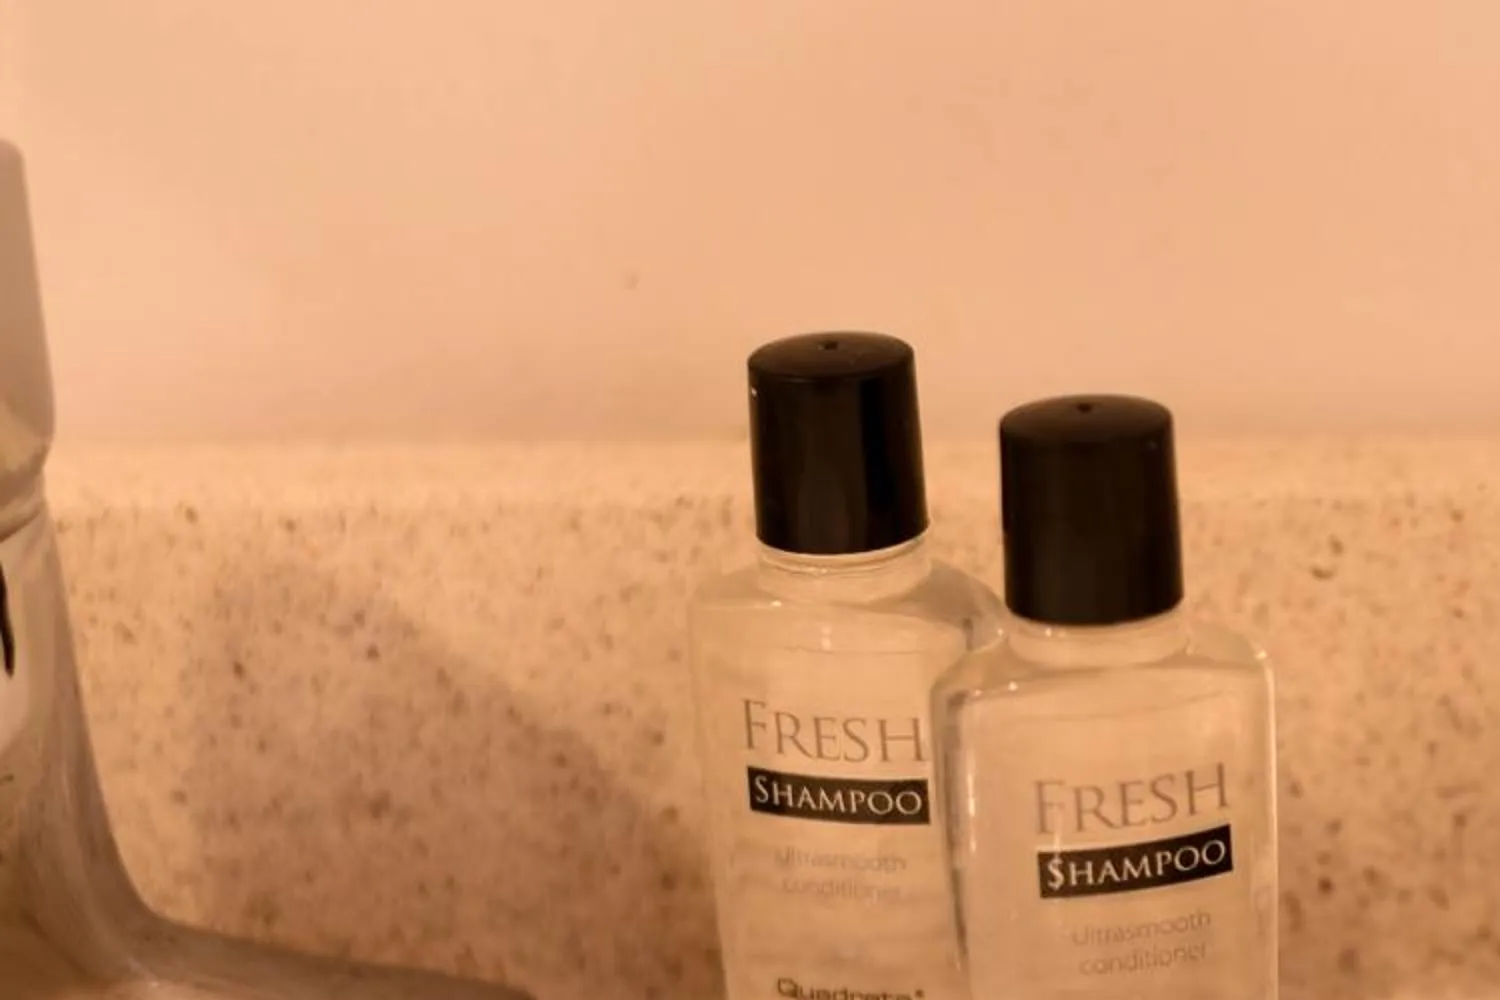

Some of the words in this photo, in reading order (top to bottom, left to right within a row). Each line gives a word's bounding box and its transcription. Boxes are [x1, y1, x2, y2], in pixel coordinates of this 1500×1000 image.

[741, 698, 929, 763] FRESH
[754, 774, 922, 815] SHAMPOO
[1034, 762, 1230, 835] FRESH
